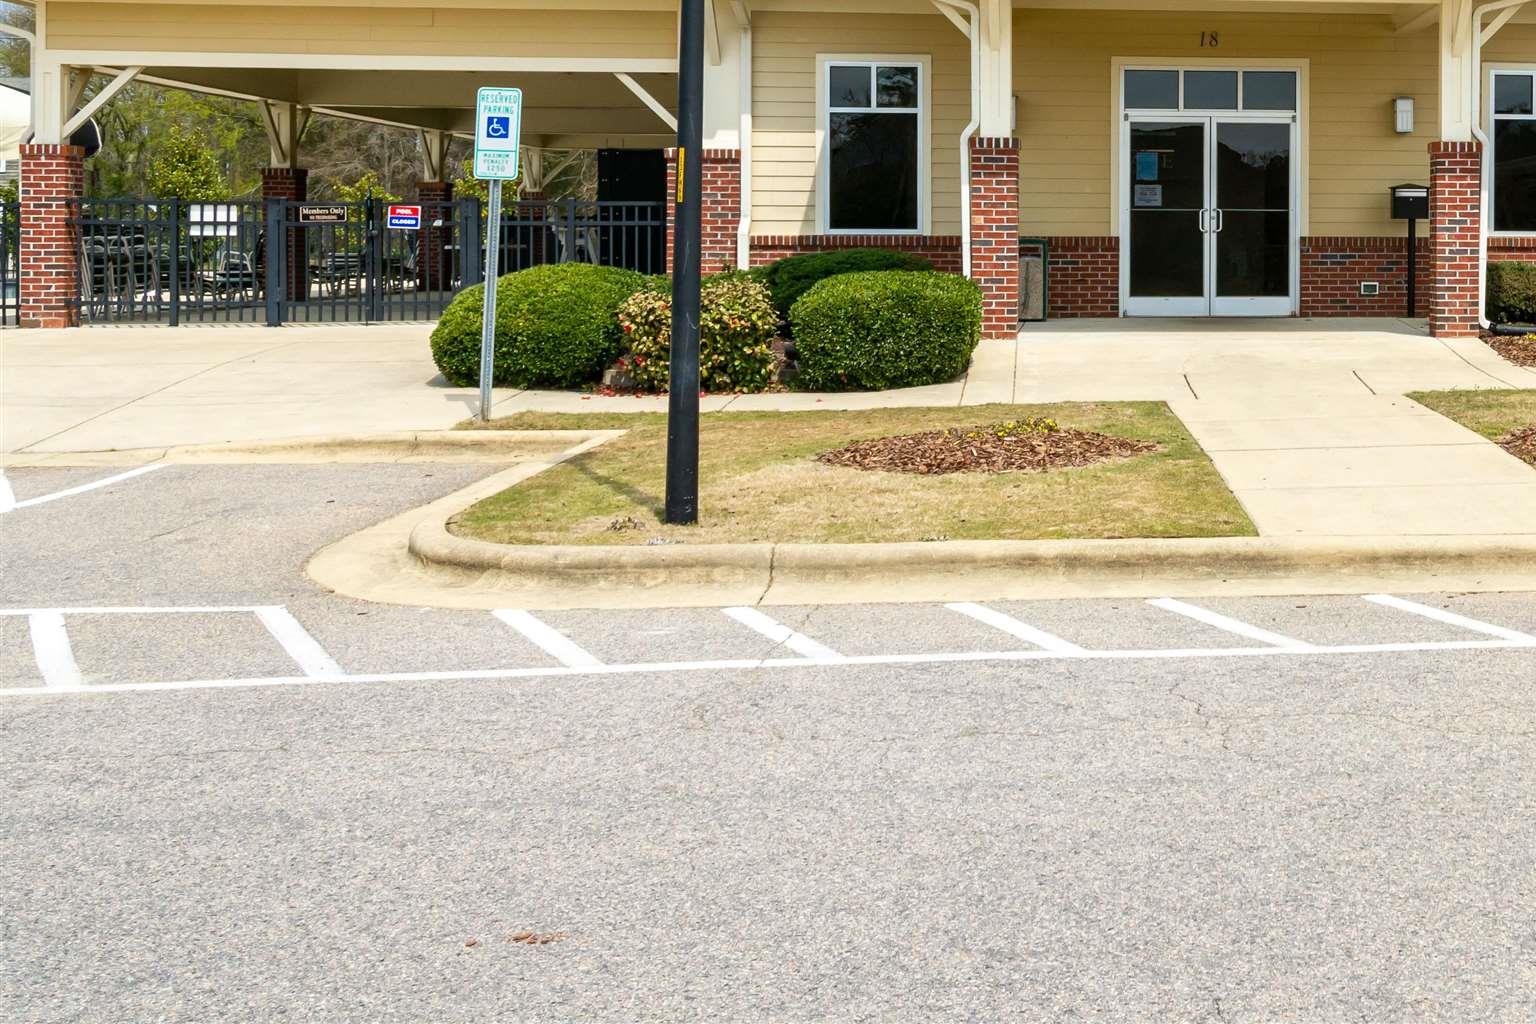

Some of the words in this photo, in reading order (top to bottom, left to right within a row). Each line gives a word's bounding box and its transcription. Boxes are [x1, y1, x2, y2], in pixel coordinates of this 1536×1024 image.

[1200, 31, 1219, 48] 18
[480, 94, 518, 104] RESERVED
[484, 105, 514, 114] PARKING
[330, 207, 344, 215] Only
